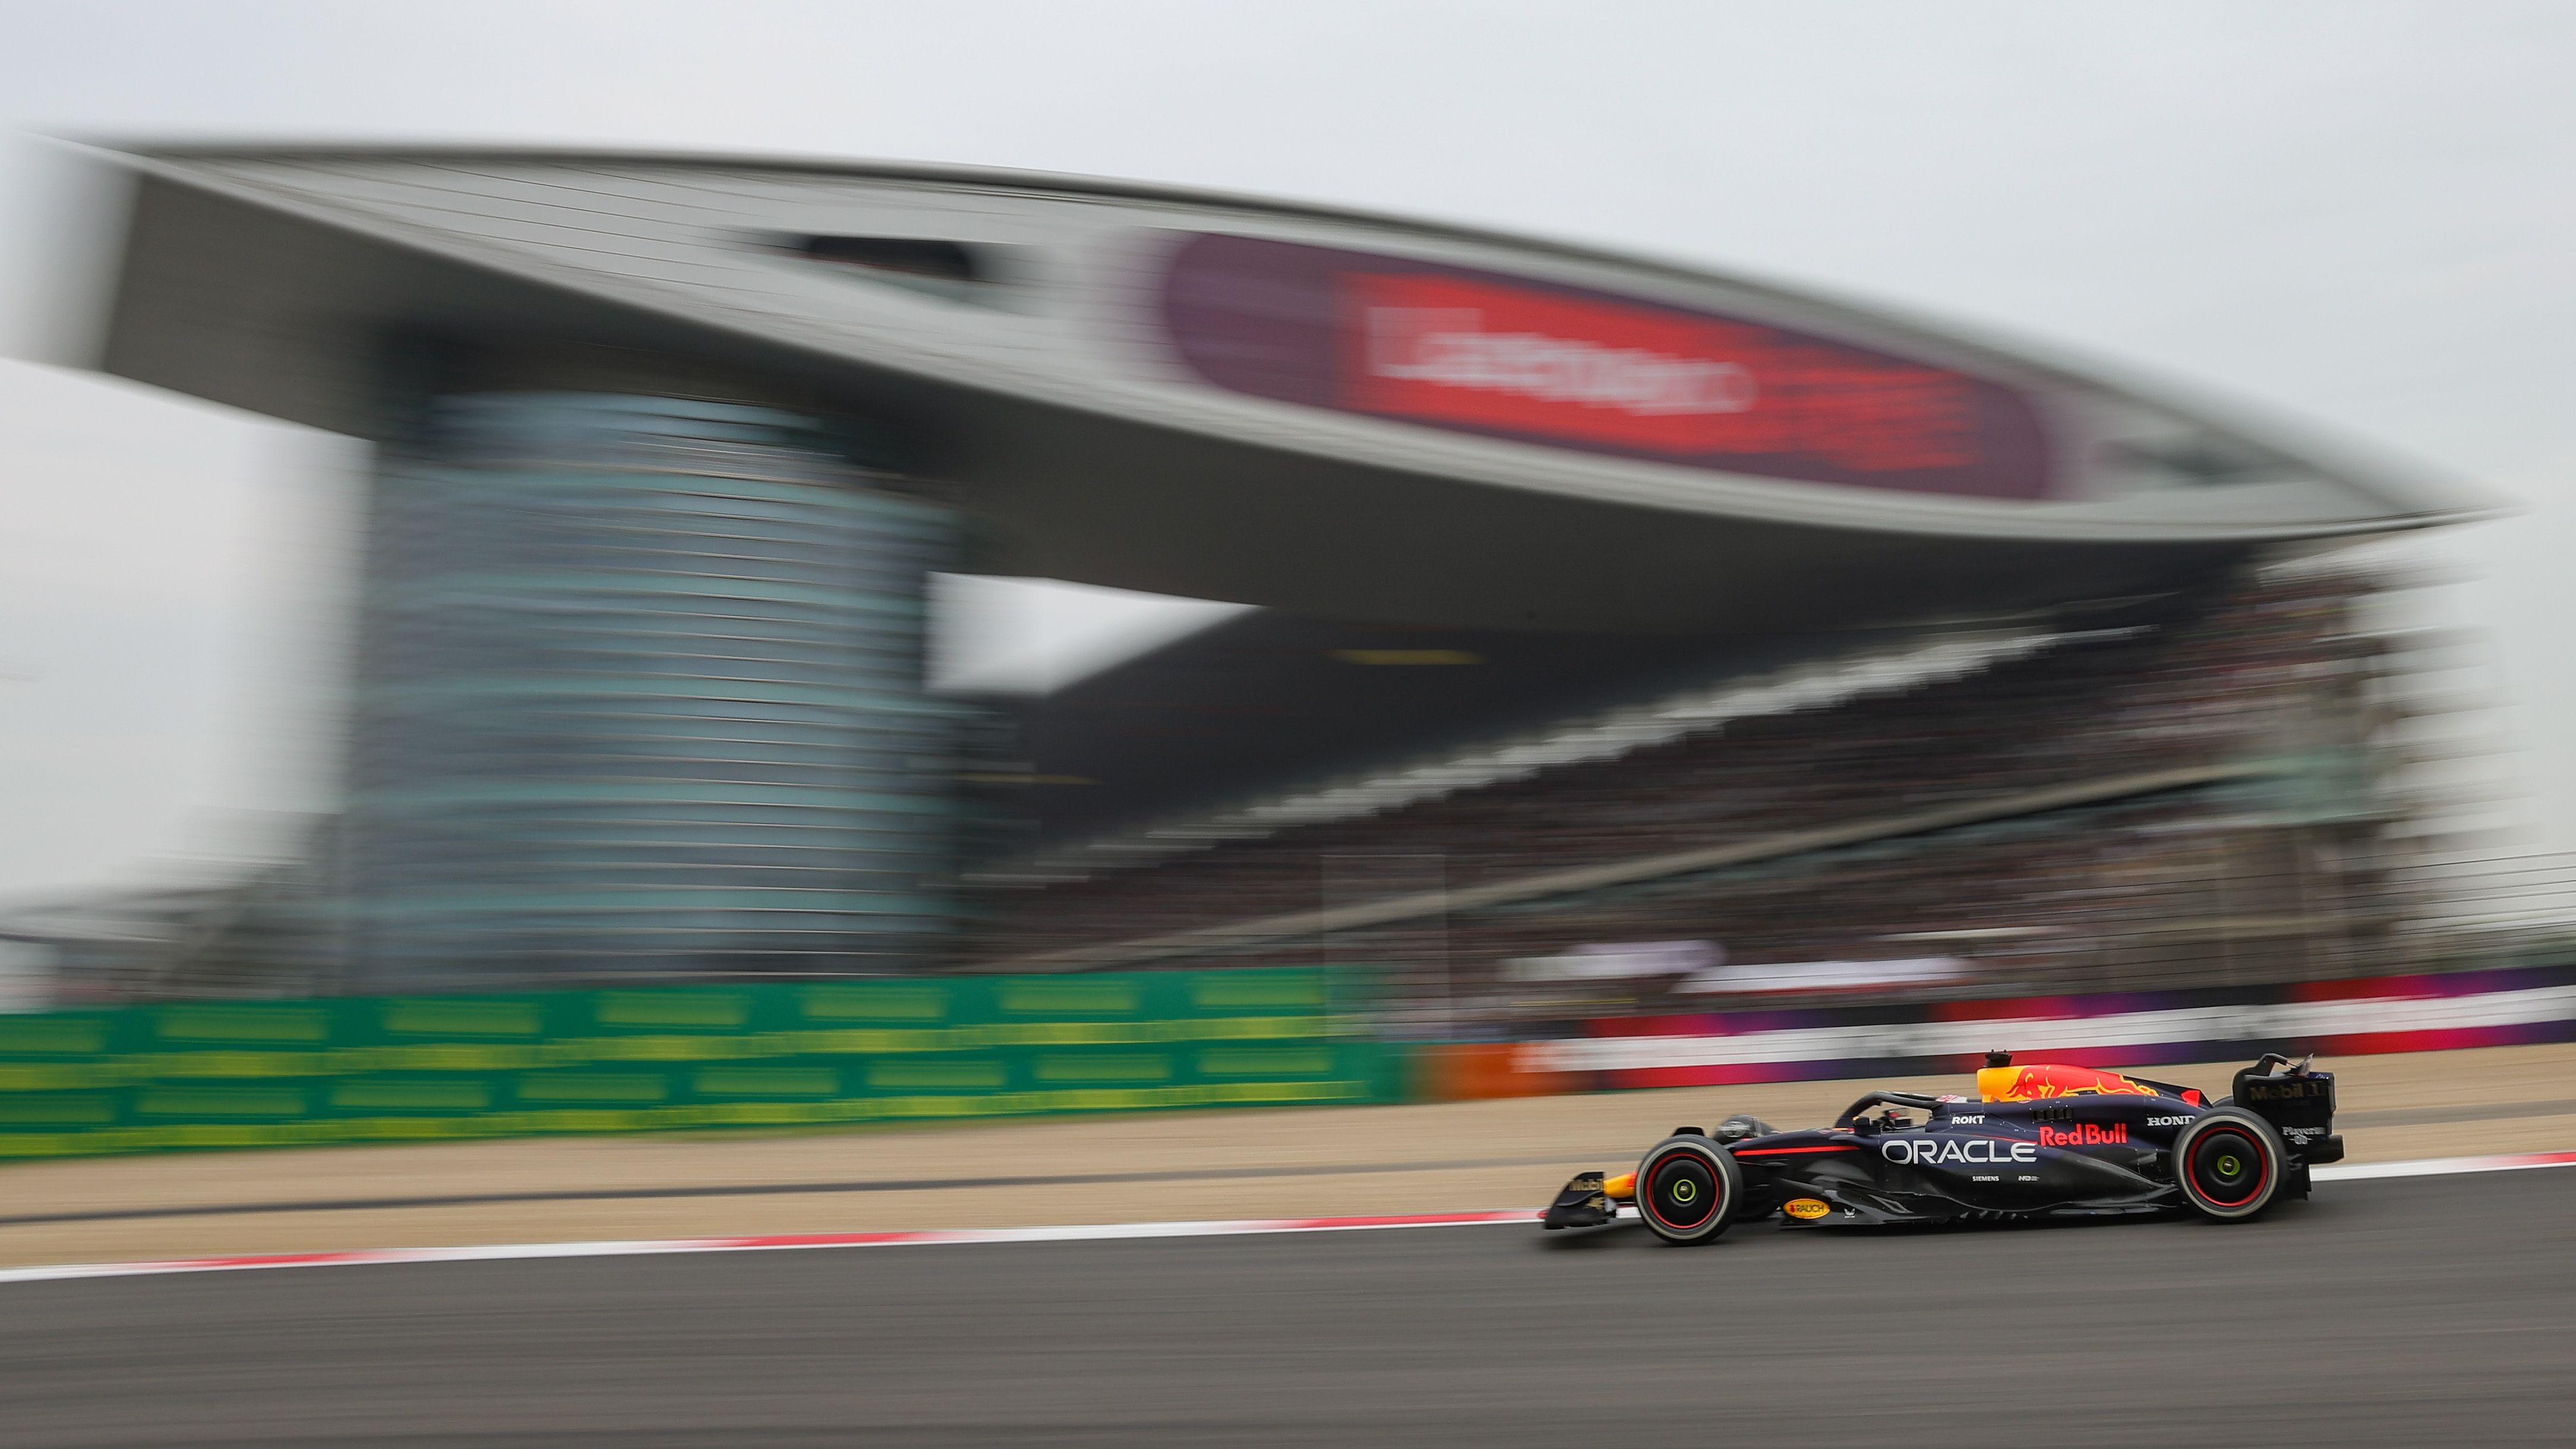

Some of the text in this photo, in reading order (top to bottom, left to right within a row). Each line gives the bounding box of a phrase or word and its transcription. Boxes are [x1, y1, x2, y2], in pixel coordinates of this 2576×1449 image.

[2250, 1083, 2304, 1101] Mobil
[1952, 1115, 1985, 1125] ROKT
[2146, 1115, 2196, 1126] HOND
[2040, 1123, 2127, 1147] Red Bull
[1882, 1139, 2037, 1164] ORACLE
[1796, 1204, 1824, 1213] RAUCH
